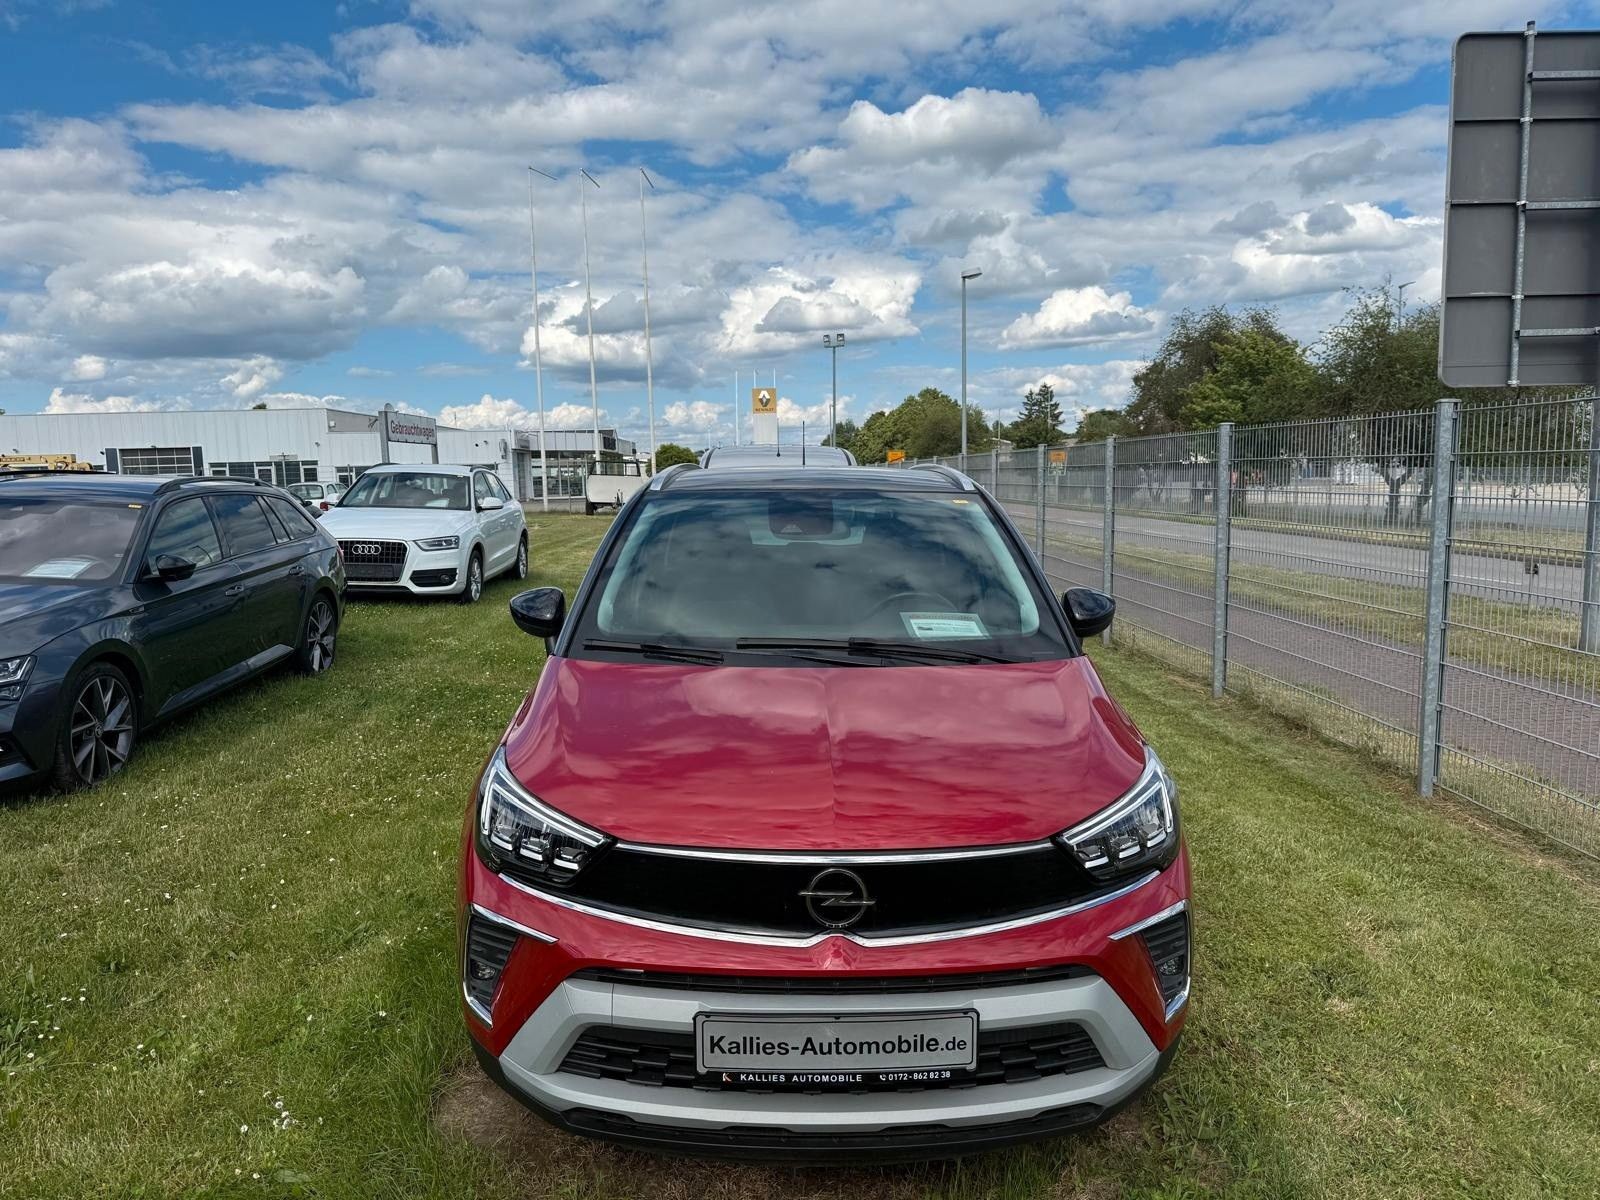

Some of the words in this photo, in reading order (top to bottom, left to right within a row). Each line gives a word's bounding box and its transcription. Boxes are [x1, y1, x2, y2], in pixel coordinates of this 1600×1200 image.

[391, 420, 434, 440] Gebrauchtwagen
[709, 1034, 967, 1055] Kallies-Automobile.de
[740, 1073, 786, 1082] KALLIES
[792, 1074, 862, 1083] AUTOMOBILE
